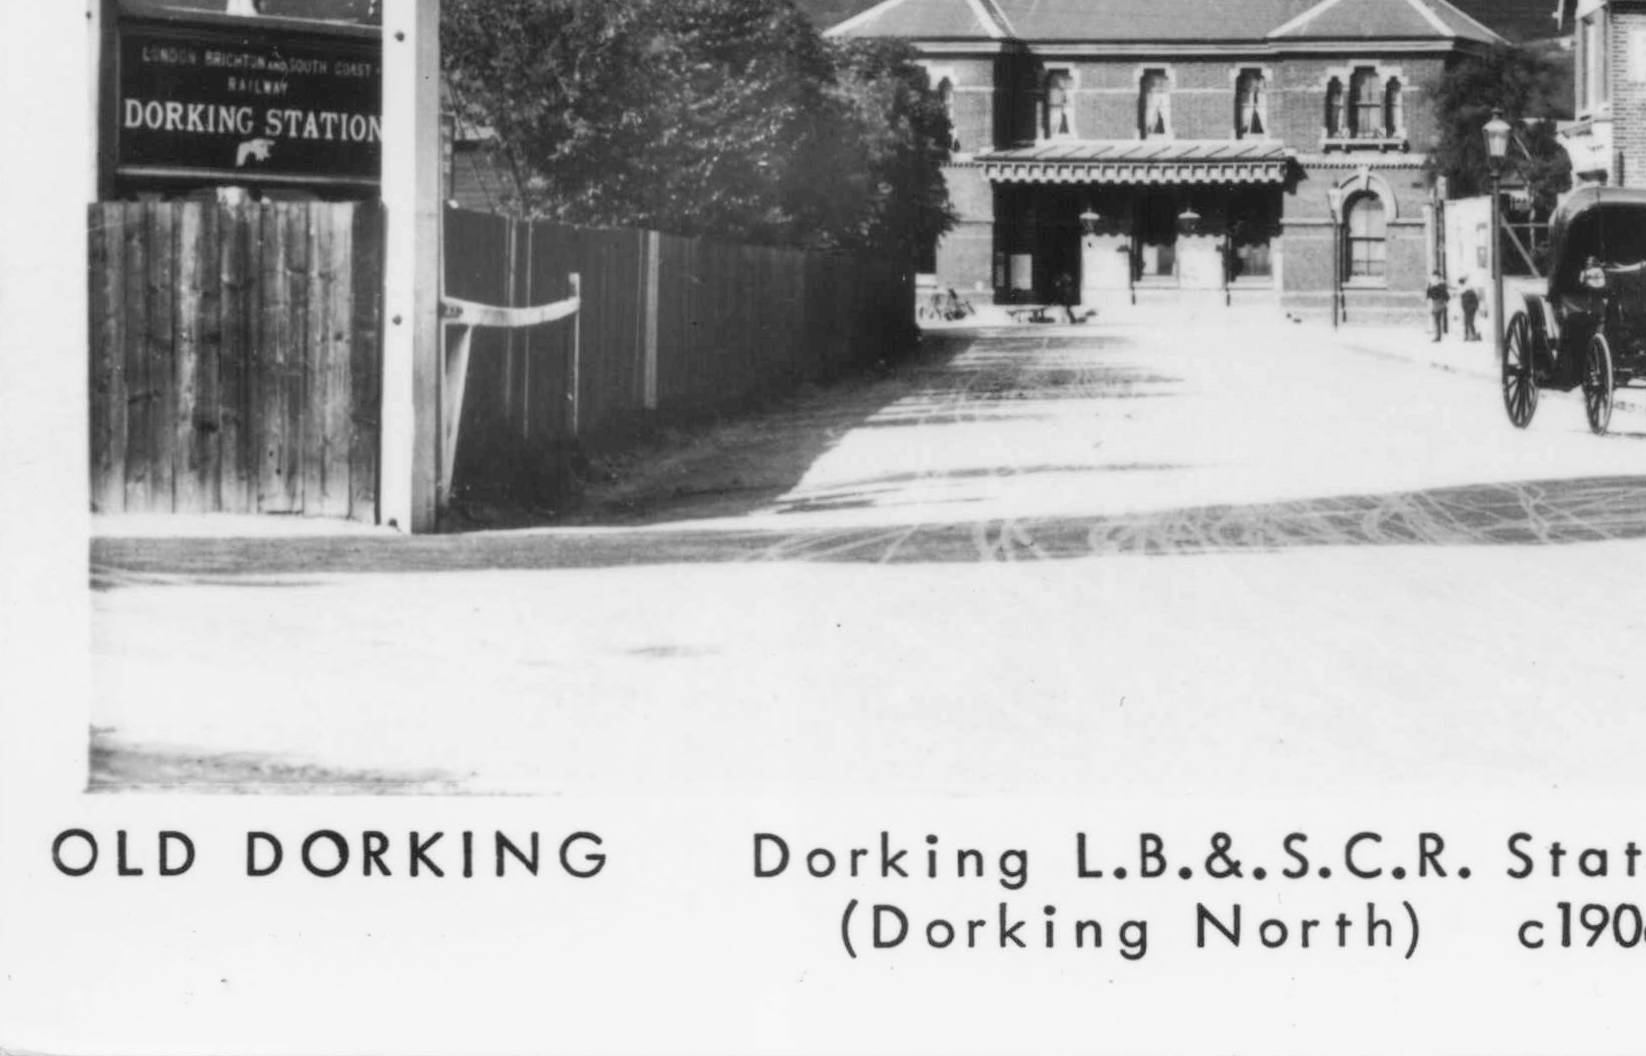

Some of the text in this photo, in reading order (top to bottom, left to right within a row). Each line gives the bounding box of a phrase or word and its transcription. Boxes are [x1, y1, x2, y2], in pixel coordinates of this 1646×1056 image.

[142, 46, 197, 65] LONDON
[288, 57, 328, 76] SOUTH
[334, 61, 371, 79] COAST
[227, 75, 289, 95] RAILWAY
[124, 98, 382, 142] DORKING STATION
